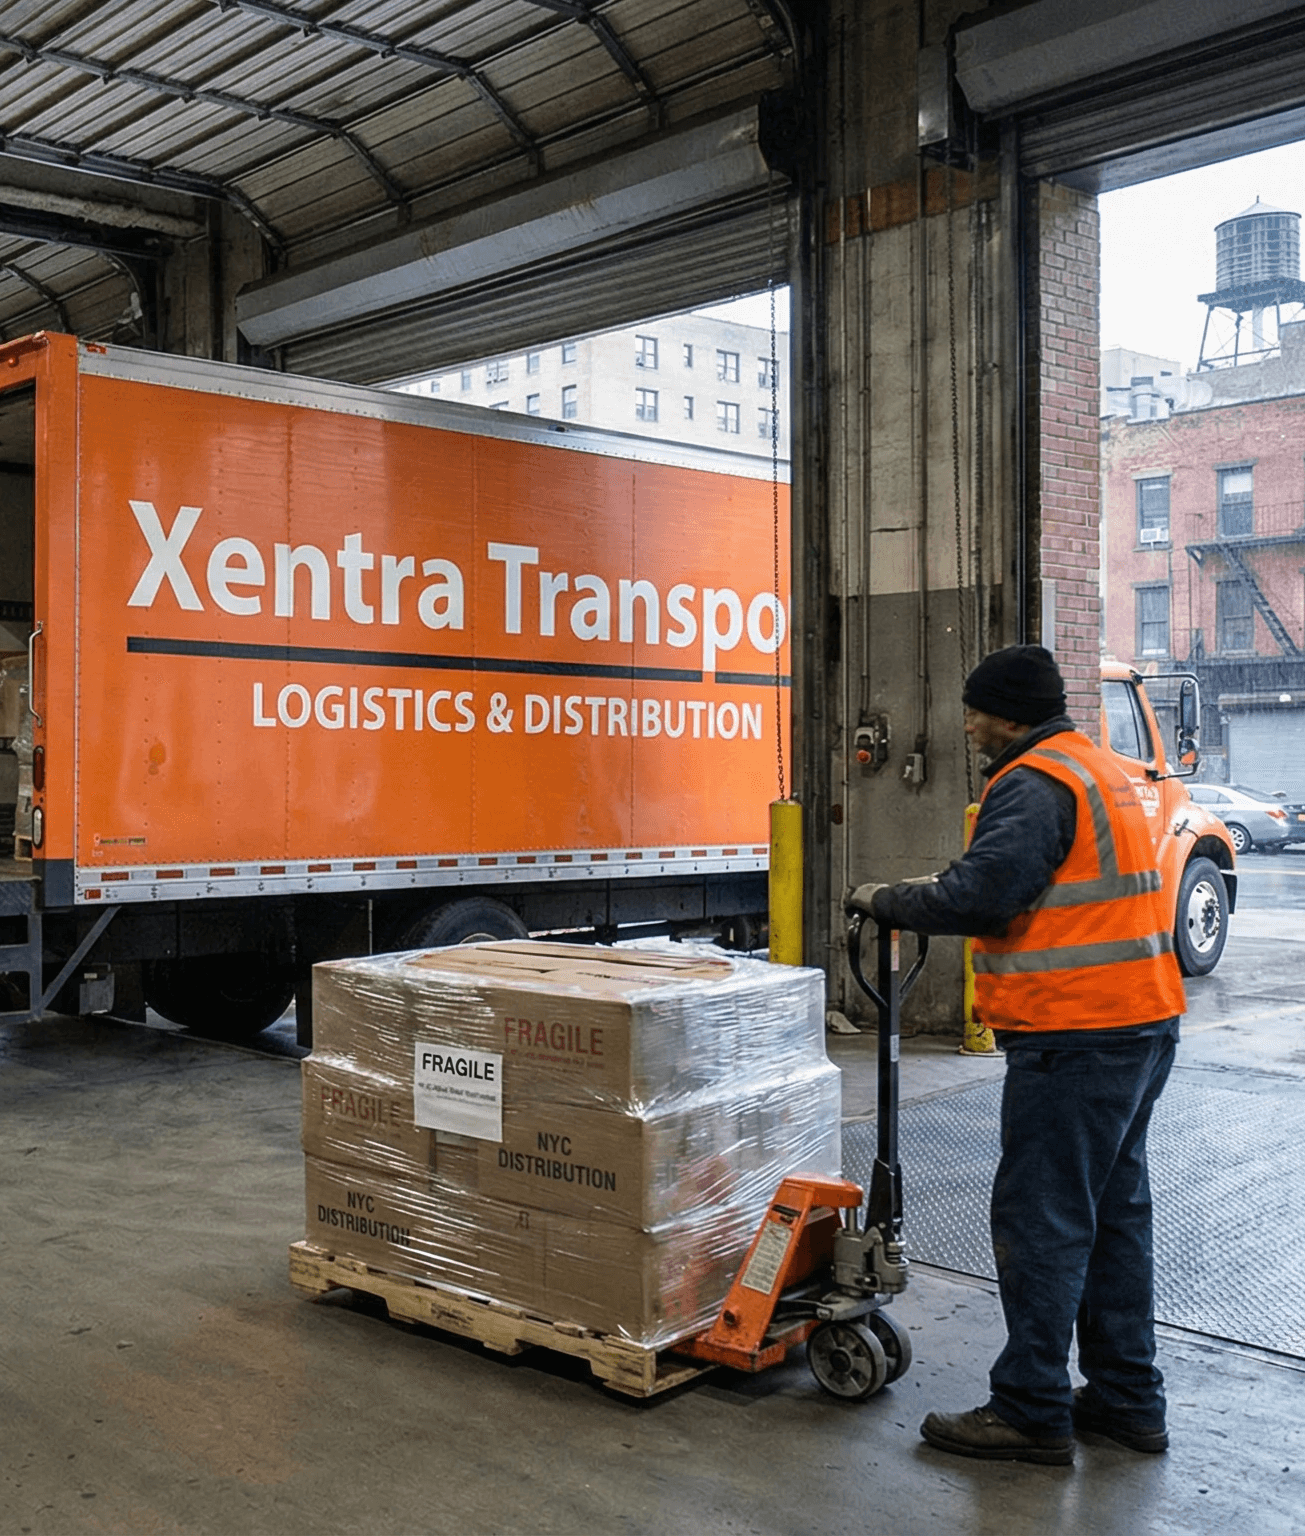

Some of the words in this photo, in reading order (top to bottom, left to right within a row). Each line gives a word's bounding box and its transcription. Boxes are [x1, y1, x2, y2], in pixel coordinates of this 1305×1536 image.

[127, 500, 465, 630] Xentra
[487, 541, 792, 672] Transpo
[253, 682, 476, 733] LOGISTICS
[486, 692, 514, 734] &
[524, 693, 762, 741] DISTRIBUTION
[504, 1017, 604, 1056] FRAGILE
[422, 1052, 495, 1082] FRAGILE
[321, 1086, 401, 1128] FRAGILE
[537, 1131, 573, 1156] NYC
[498, 1147, 616, 1192] DISTRIBUTION
[347, 1191, 376, 1213] NYC
[318, 1204, 411, 1247] DISTRIBUTION
